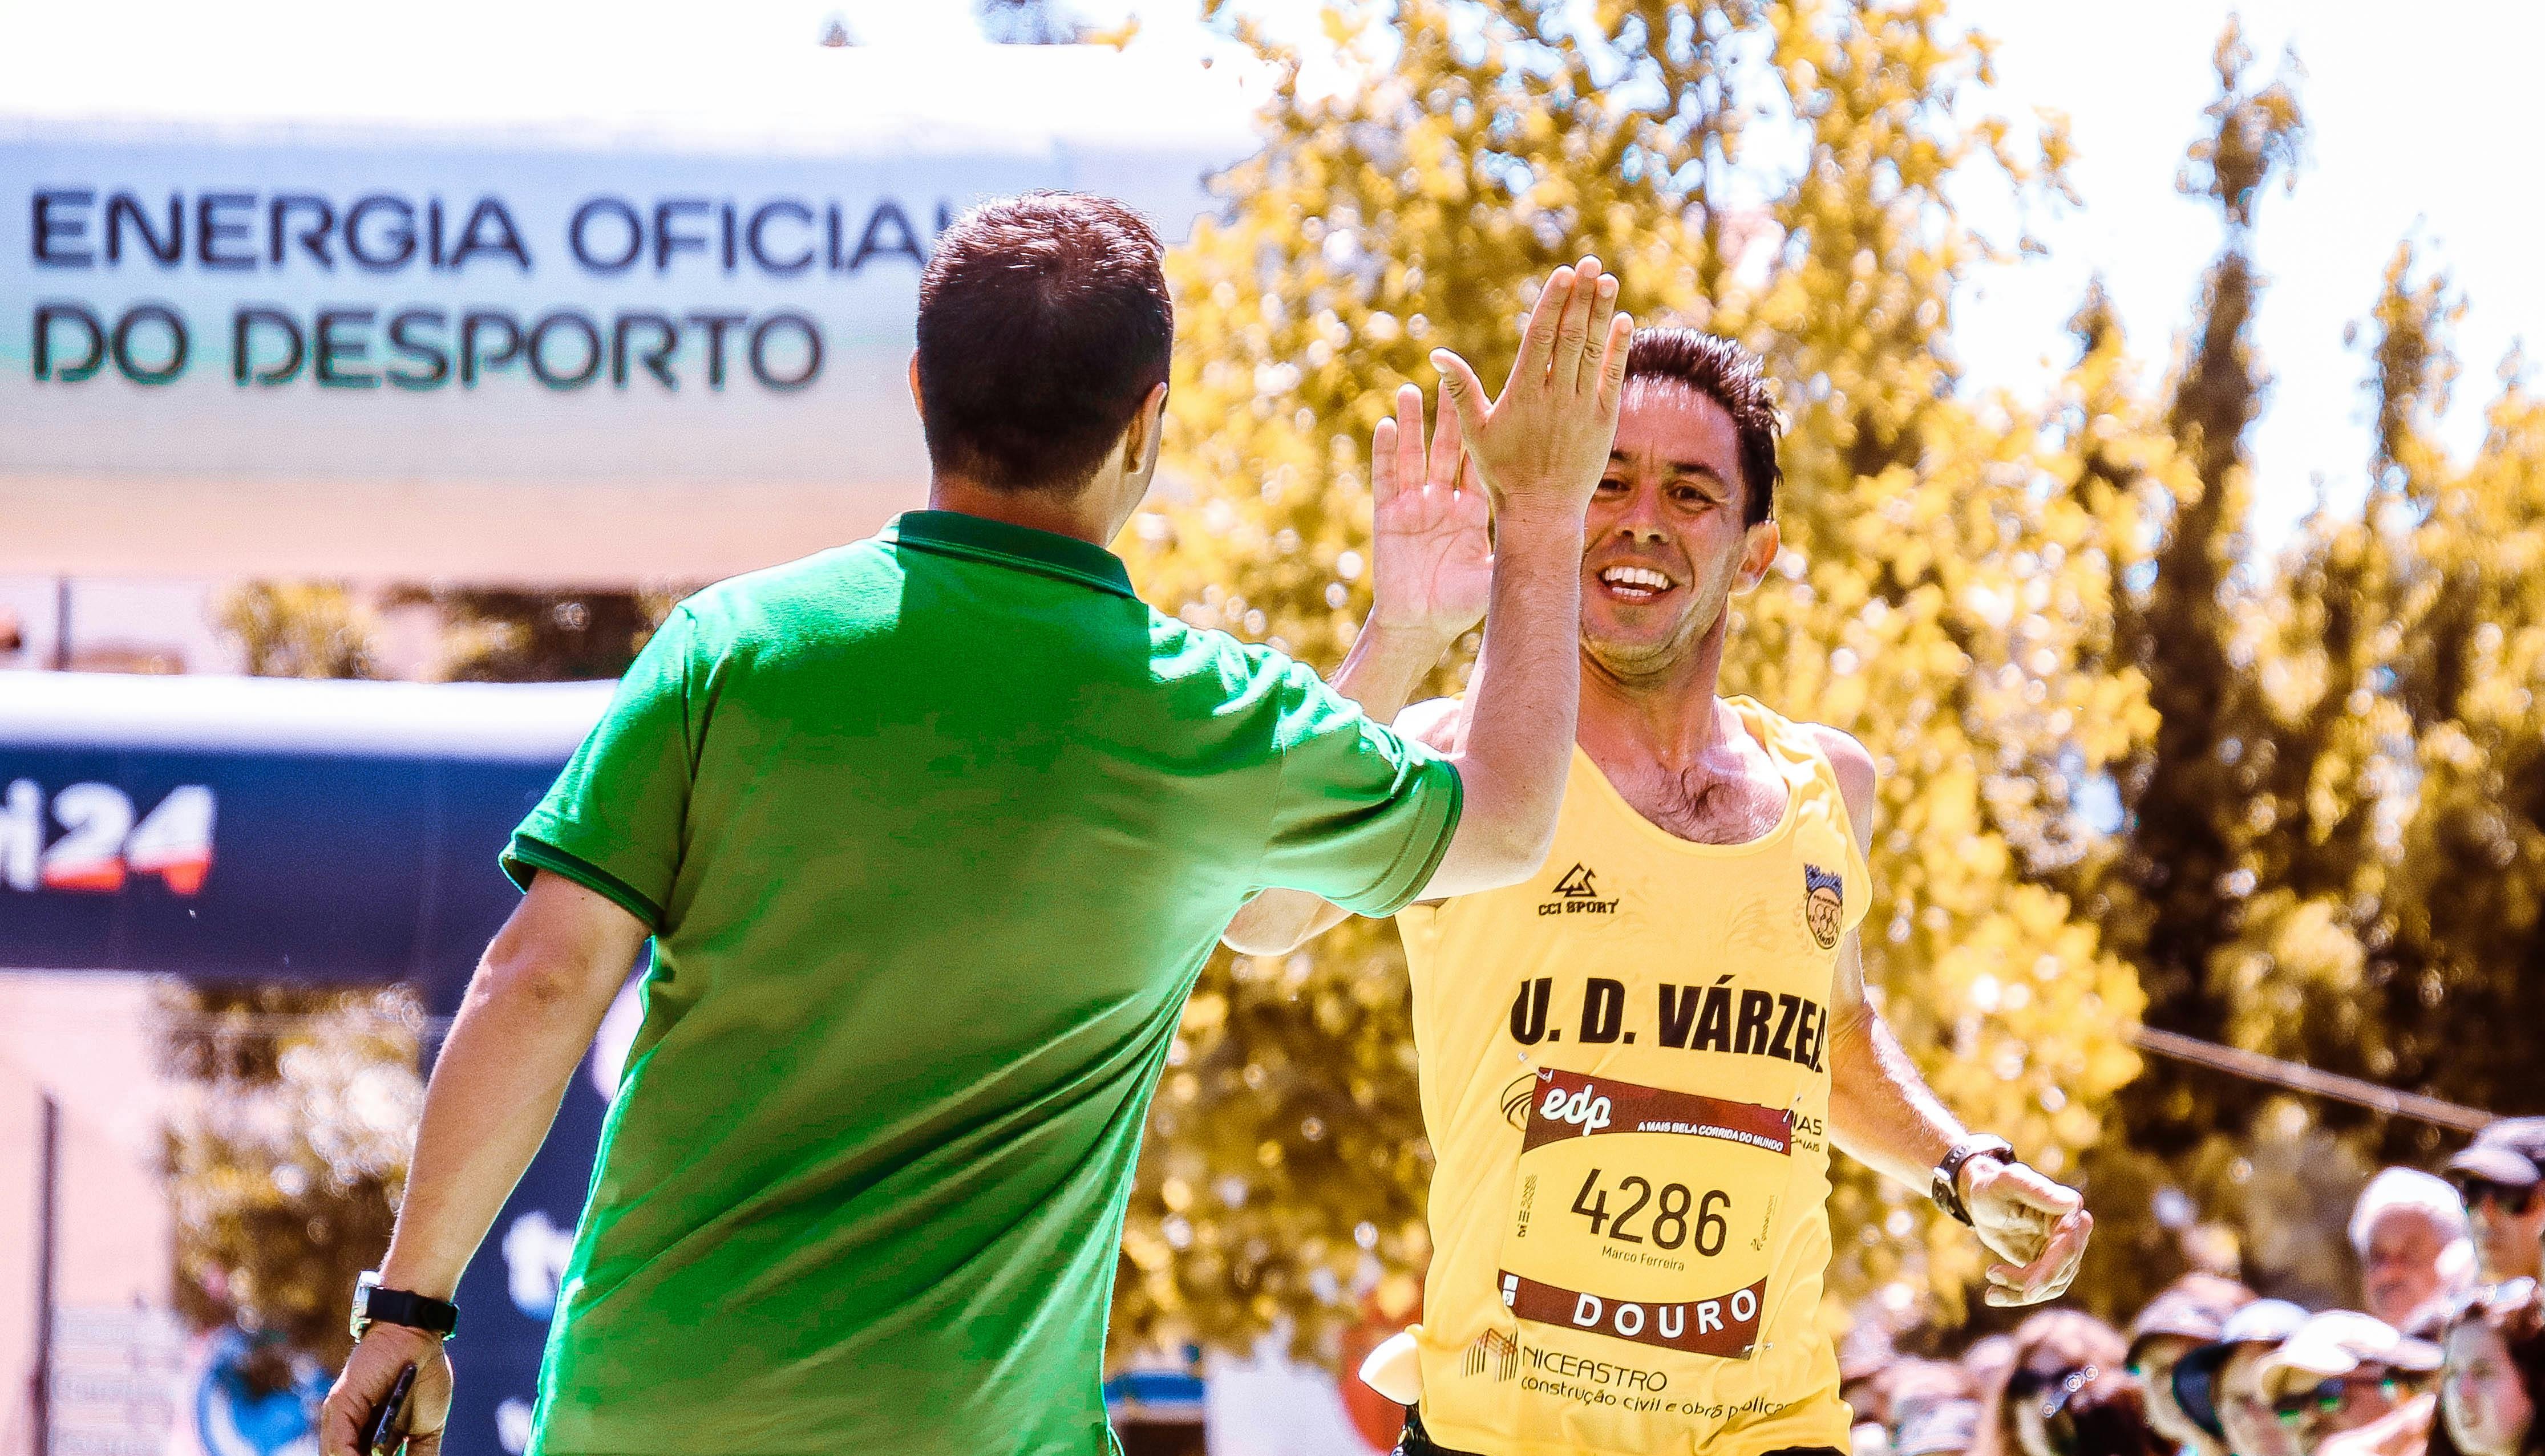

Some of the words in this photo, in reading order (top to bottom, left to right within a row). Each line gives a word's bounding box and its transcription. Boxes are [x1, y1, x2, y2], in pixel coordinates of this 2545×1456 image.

[31, 188, 532, 273] ENERGIA
[570, 196, 950, 277] OFICIA
[33, 300, 191, 386] DO
[233, 305, 825, 392] DESPORTO
[1539, 902, 1561, 916] CCI
[1566, 898, 1620, 914] SPORT
[1510, 978, 1560, 1045] U.
[1579, 978, 1636, 1044] D.
[1540, 1084, 1611, 1137] edp
[1637, 1121, 1645, 1132] A
[1646, 1121, 1671, 1132] MAIS
[1671, 1122, 1698, 1134] BELA
[1698, 1125, 1738, 1141] CORRIDA
[1738, 1131, 1753, 1143] DO
[1752, 1134, 1784, 1152] MUNDO
[1571, 1168, 1731, 1257] 4286
[1601, 1246, 1637, 1263] Marco
[1640, 1253, 1685, 1272] Ferreira
[1572, 1288, 1757, 1339] DOURO
[1522, 1345, 1667, 1392] NICEASTRO
[1522, 1376, 1616, 1406] construção
[1623, 1397, 1661, 1412] civil
[1665, 1403, 1677, 1412] e
